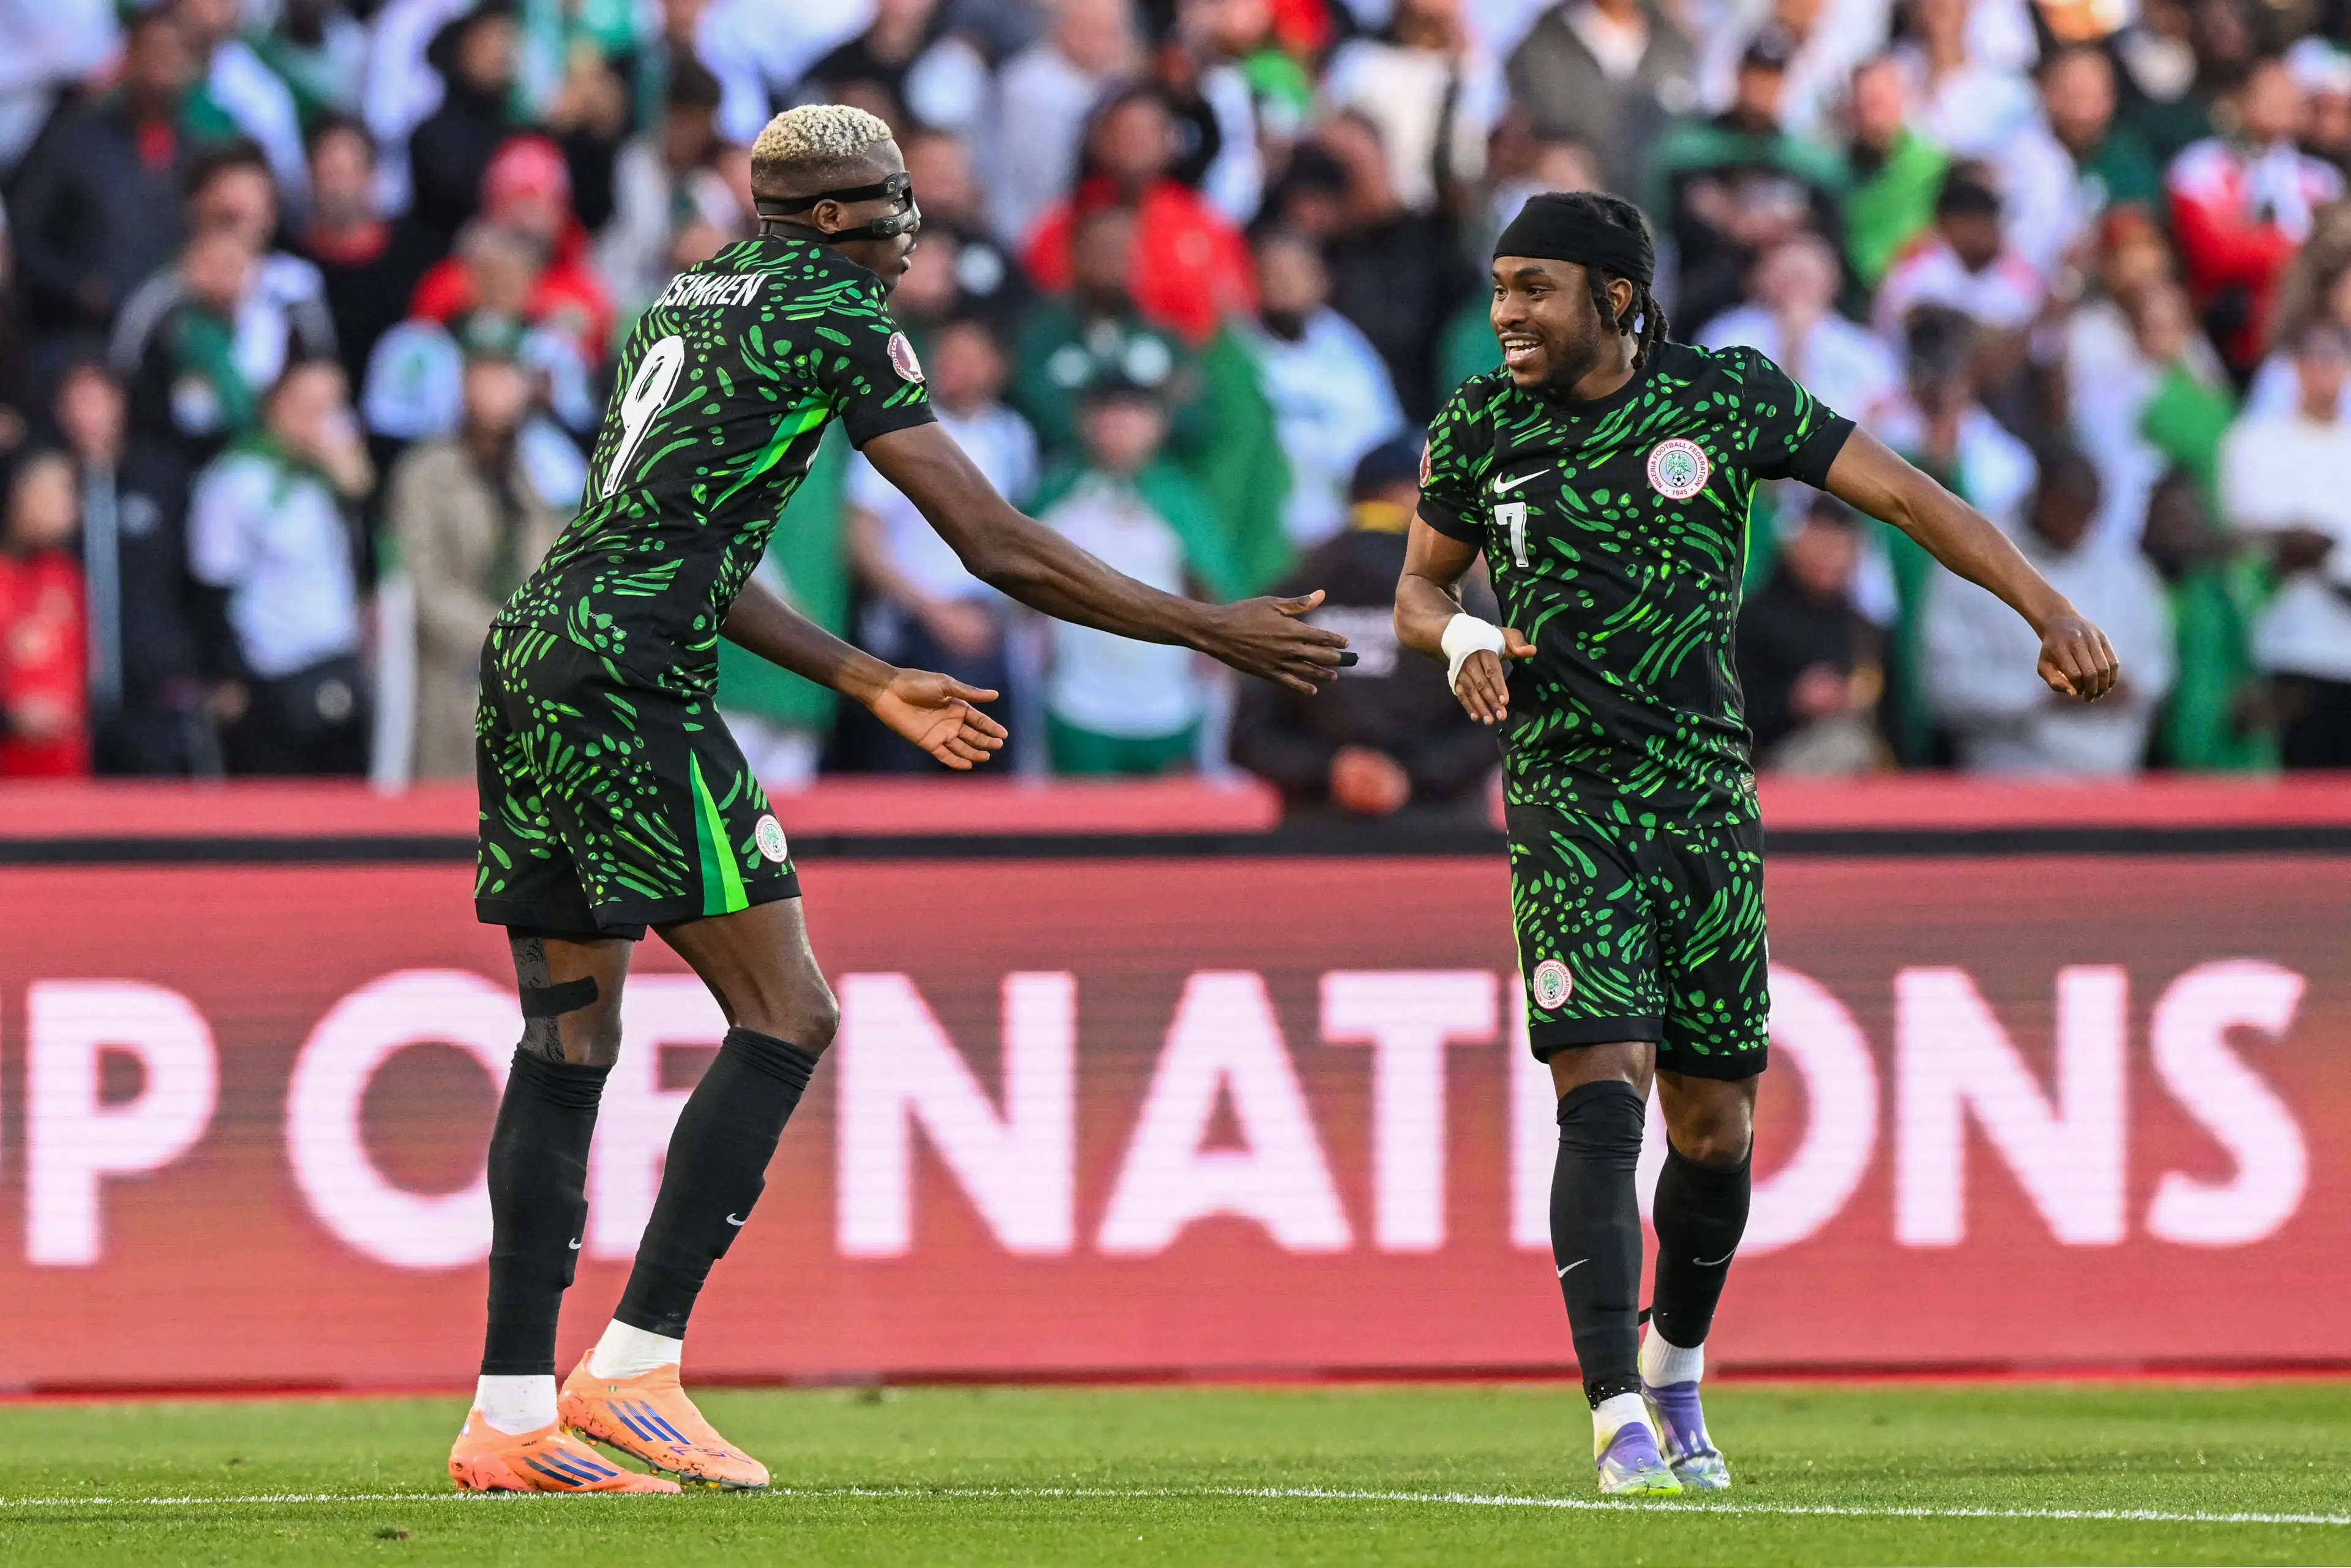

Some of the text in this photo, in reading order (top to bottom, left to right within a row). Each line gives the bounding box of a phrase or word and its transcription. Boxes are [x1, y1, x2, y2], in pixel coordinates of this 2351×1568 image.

[602, 336, 684, 499] 9
[1650, 442, 1706, 489] NIGERIA FOOTBALL FEDERATION
[1494, 501, 1529, 567] 7
[836, 956, 2309, 1259] NATIONS
